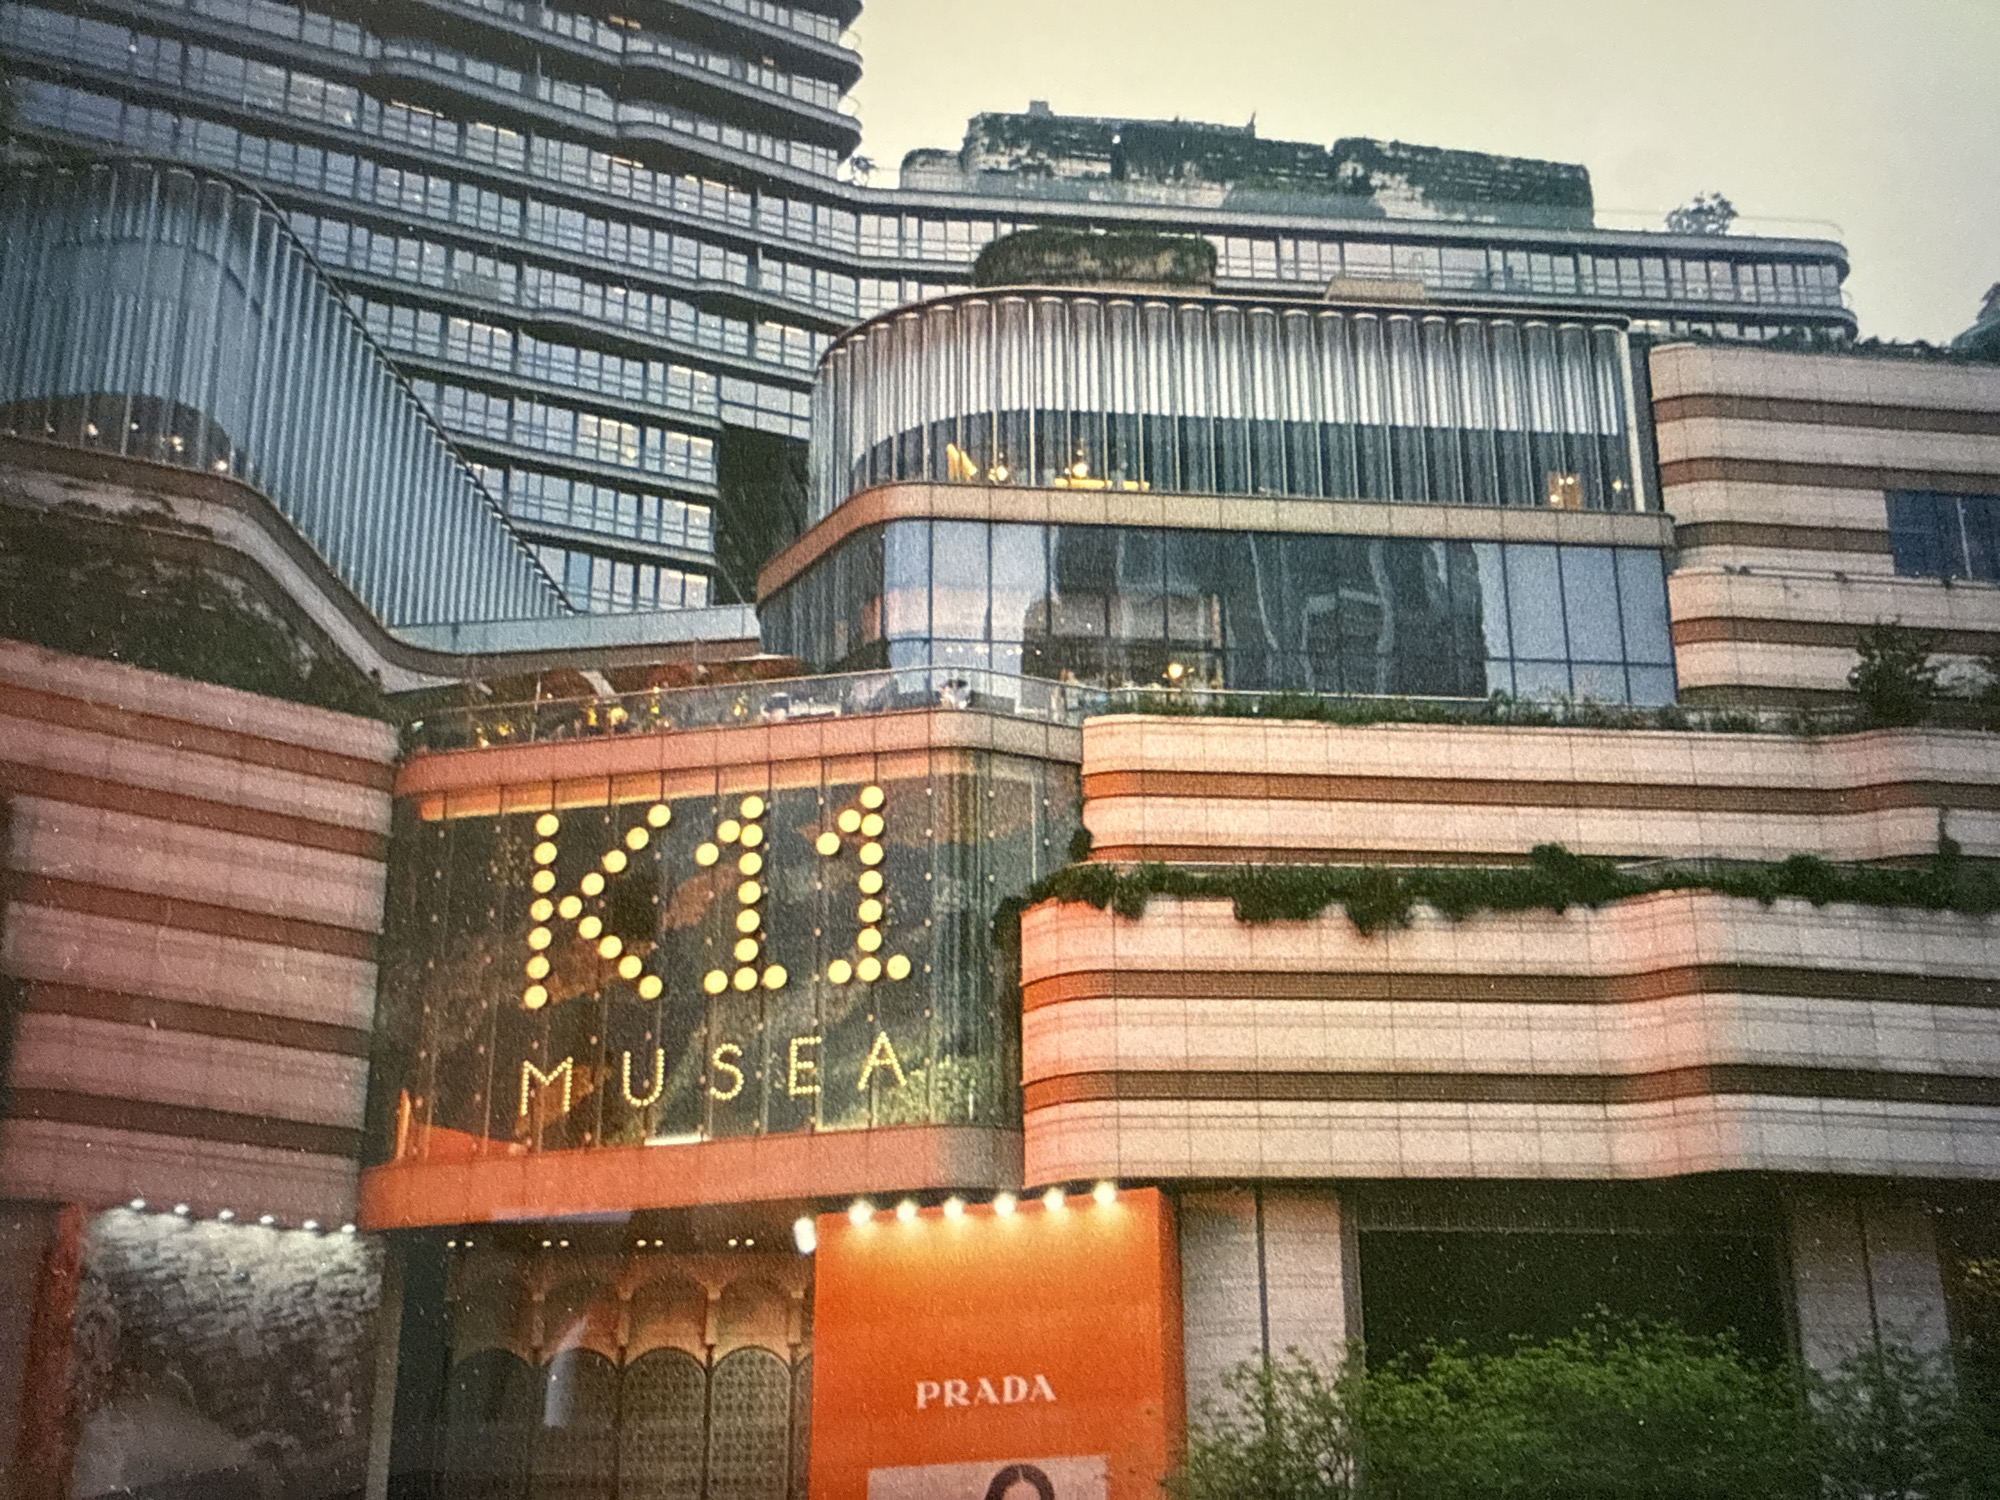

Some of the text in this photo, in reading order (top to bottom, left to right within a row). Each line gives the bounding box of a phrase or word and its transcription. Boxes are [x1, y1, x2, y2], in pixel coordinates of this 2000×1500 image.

[524, 785, 911, 1009] K11
[520, 1031, 907, 1117] MUSEA
[916, 1373, 1057, 1410] PRADA
